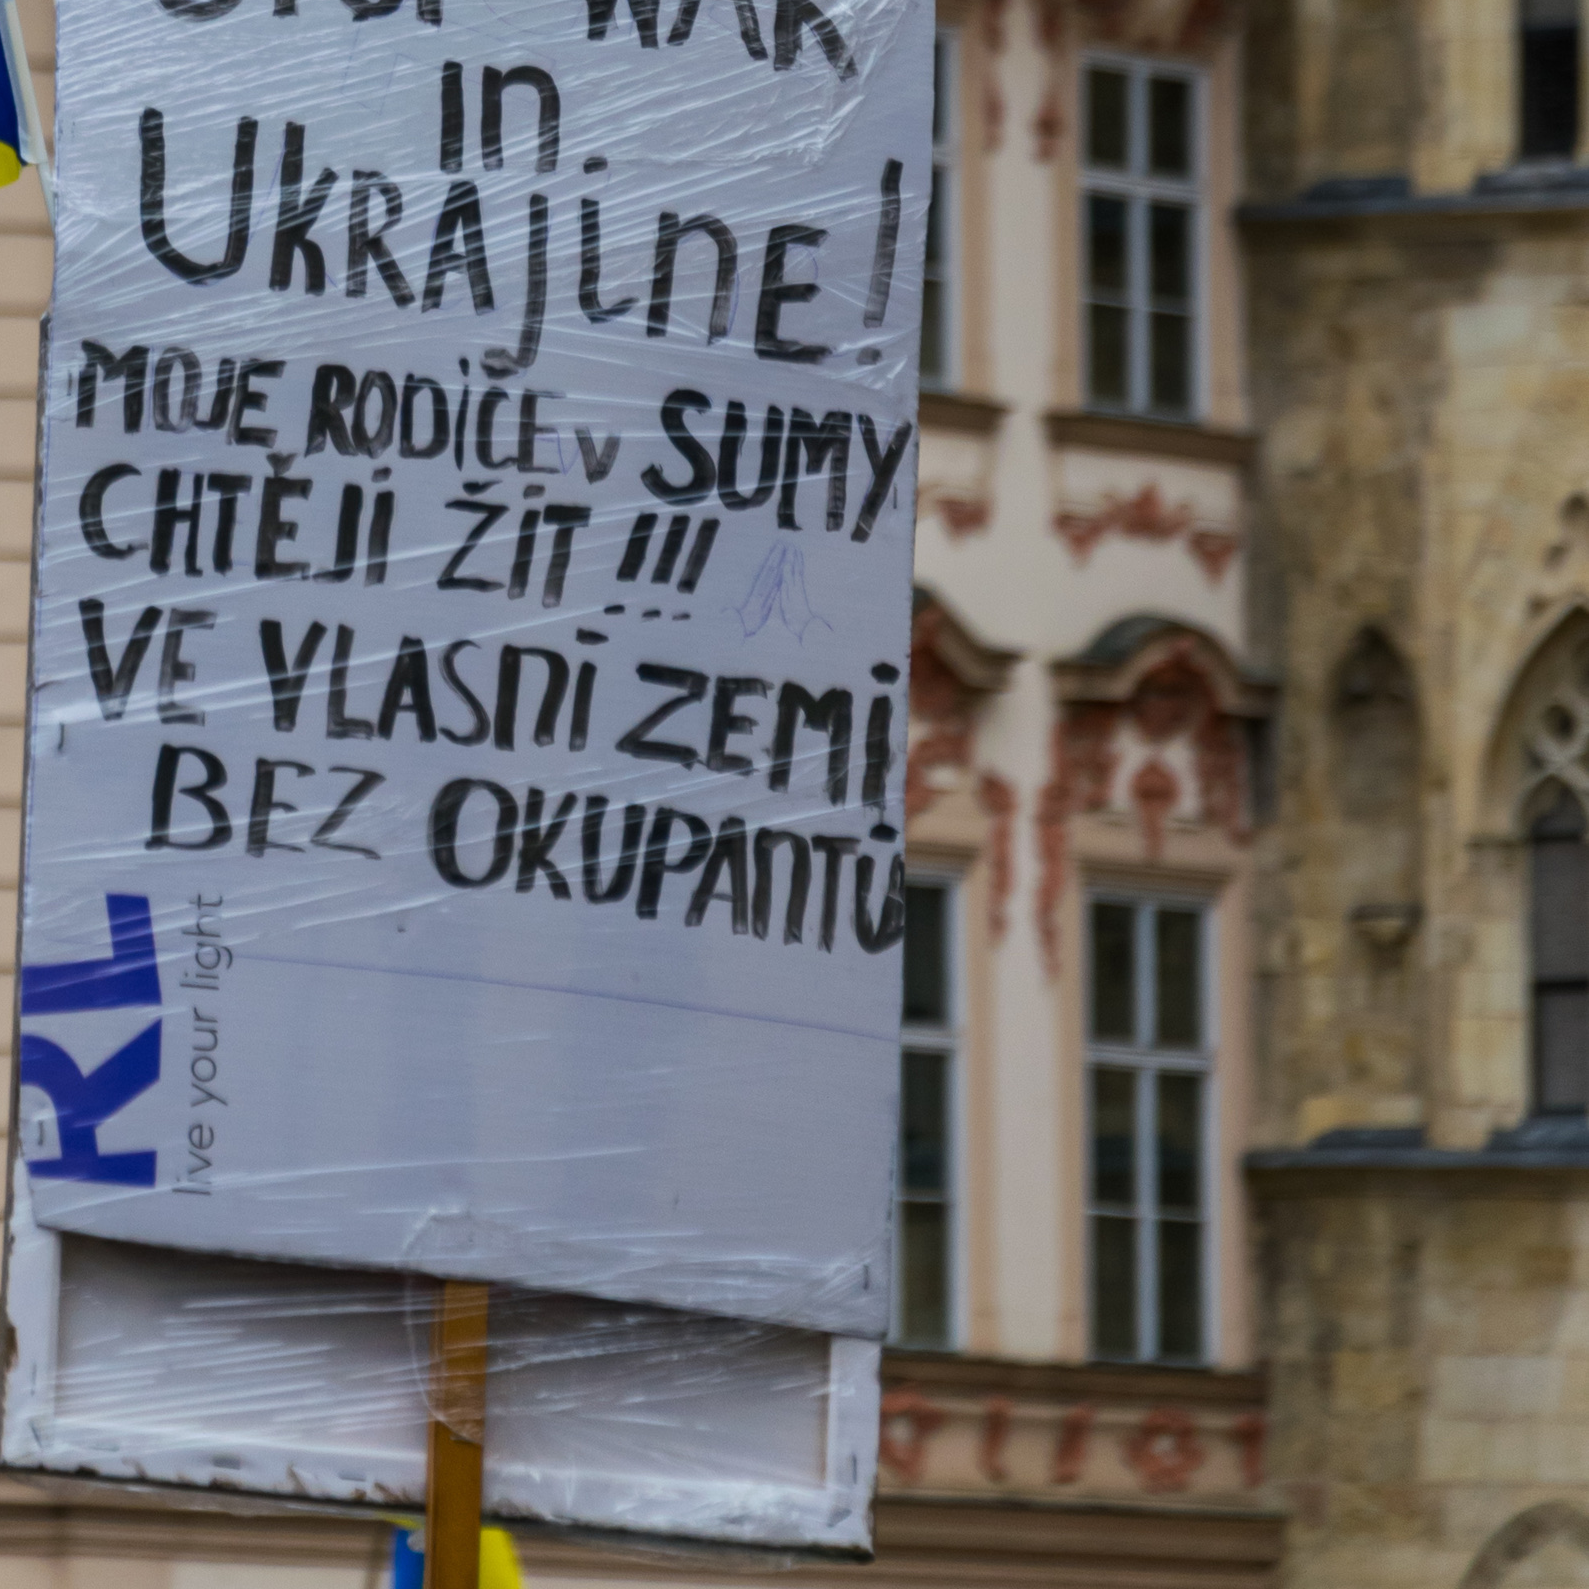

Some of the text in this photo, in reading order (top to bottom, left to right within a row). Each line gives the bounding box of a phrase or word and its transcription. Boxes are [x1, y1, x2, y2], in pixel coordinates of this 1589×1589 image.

[76, 339, 287, 448] MOJE
[641, 388, 913, 543] SUMY
[78, 598, 217, 726] VE
[144, 743, 387, 860] BEZ
[172, 892, 234, 1196] live your light
